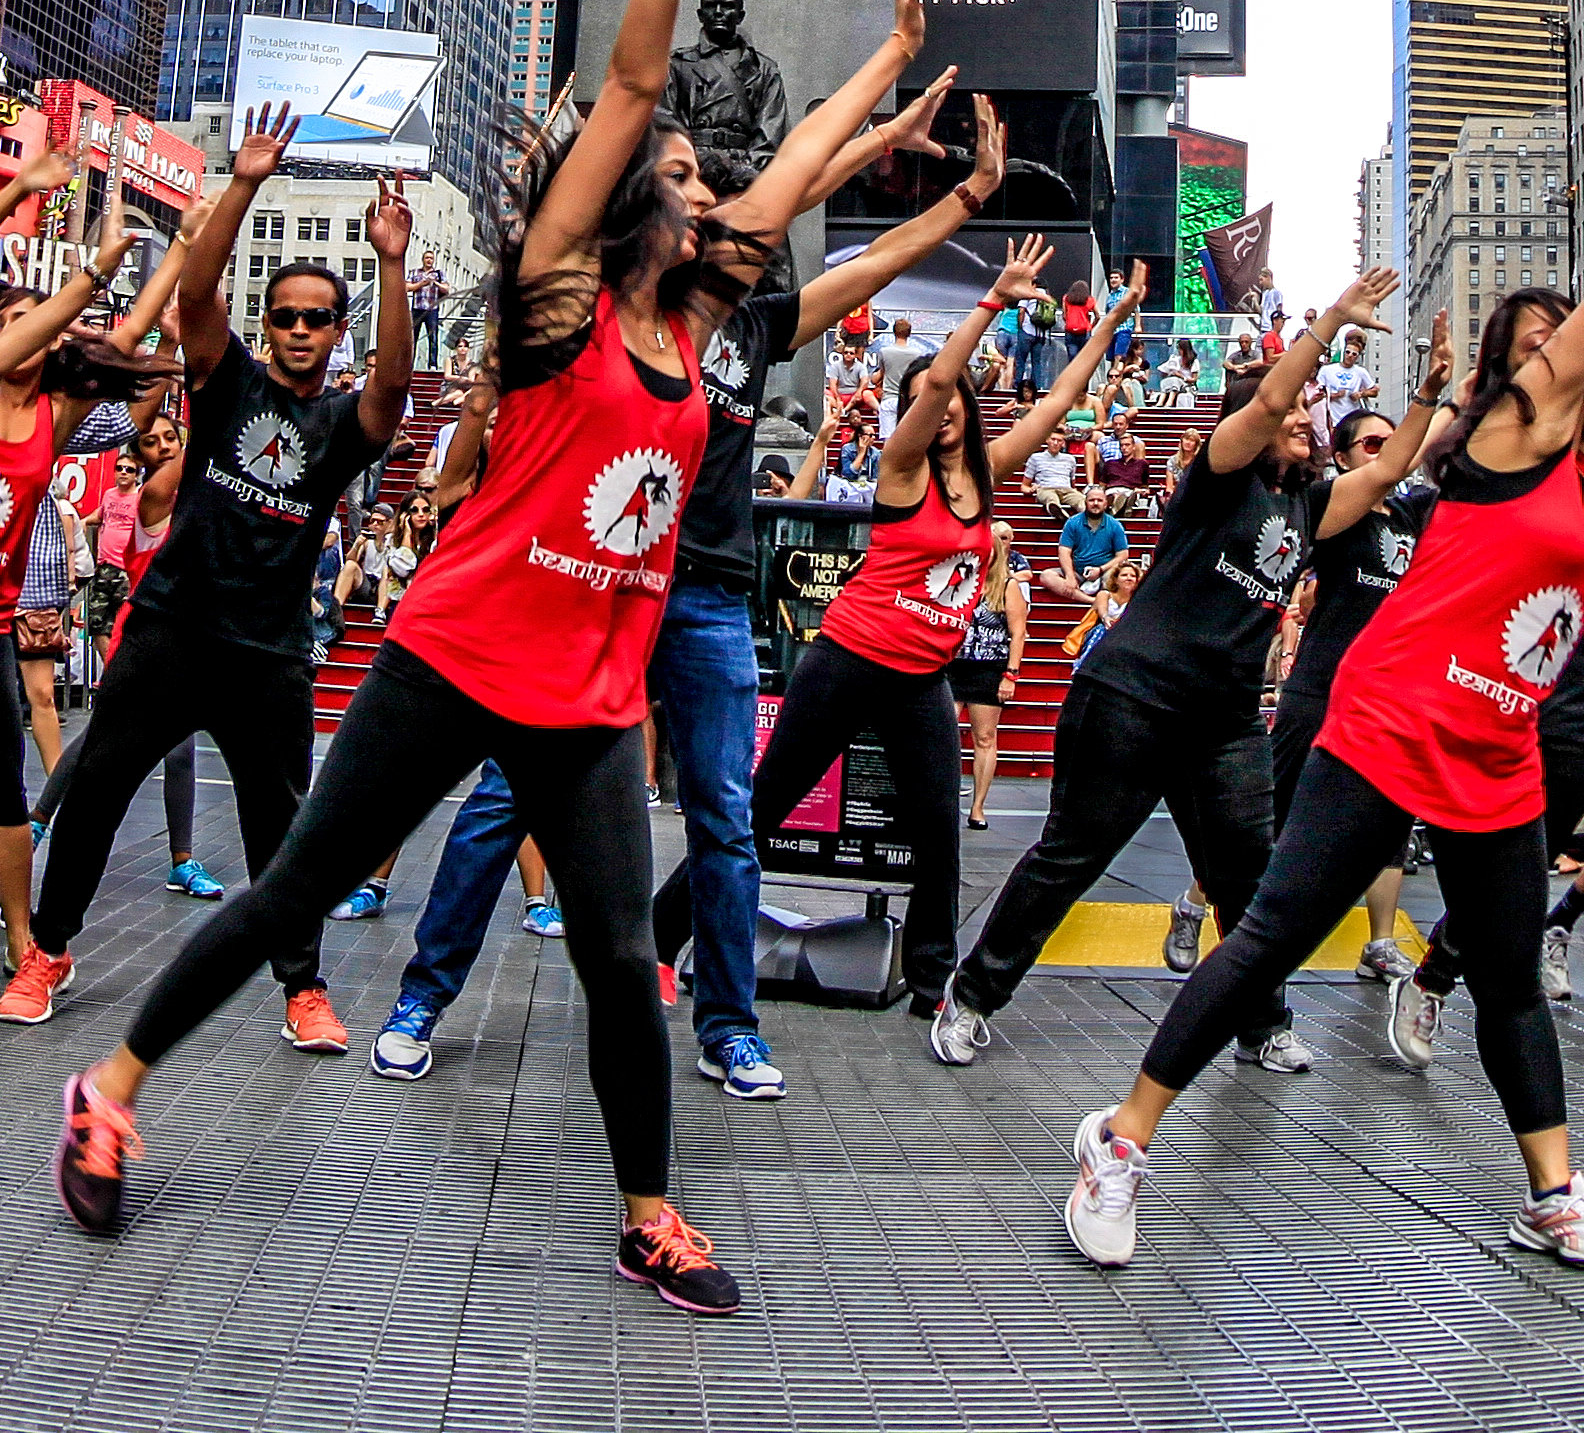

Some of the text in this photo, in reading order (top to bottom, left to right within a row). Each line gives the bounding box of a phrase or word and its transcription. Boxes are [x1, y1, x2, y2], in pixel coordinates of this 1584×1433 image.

[248, 35, 340, 54] The tablet that can
[247, 48, 345, 67] replace your laptop.
[257, 79, 320, 95] Surface Pro 3
[807, 552, 850, 570] THIS IS
[813, 569, 841, 585] NOT
[768, 838, 798, 850] TSAC
[887, 850, 912, 865] MAP
